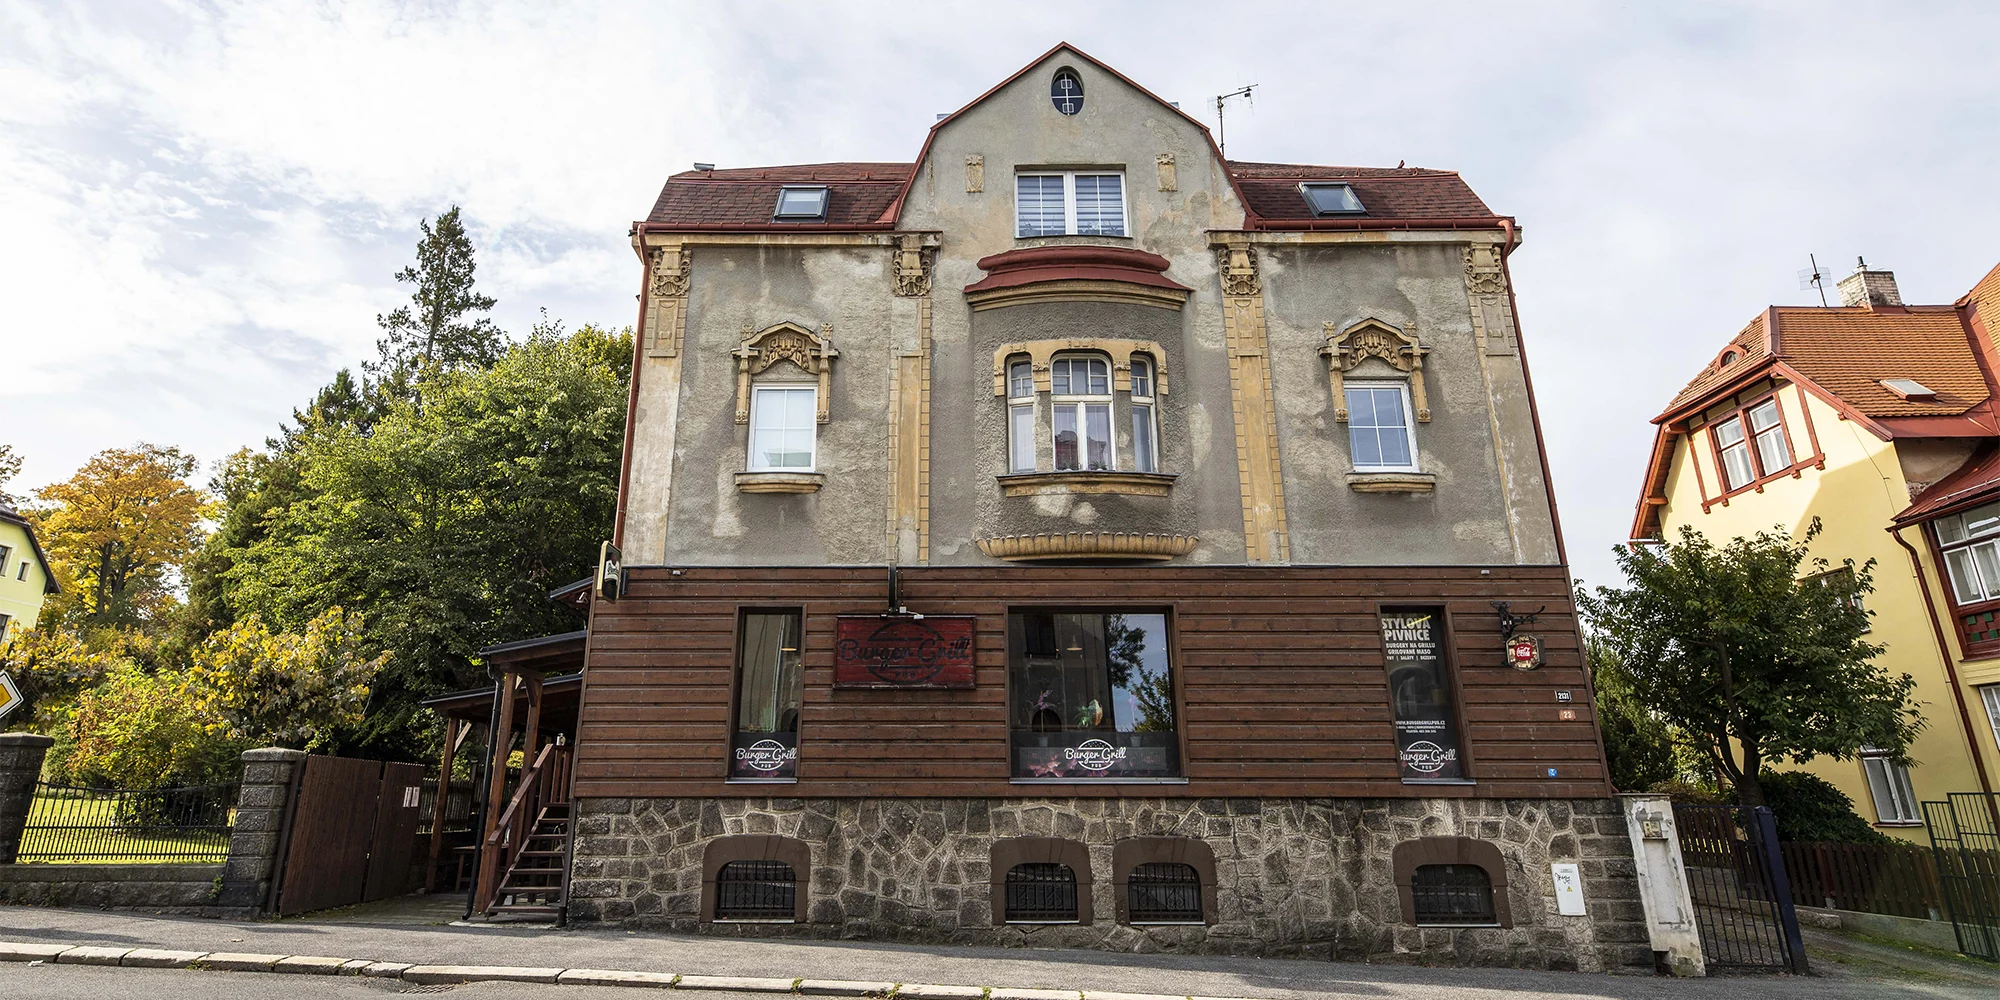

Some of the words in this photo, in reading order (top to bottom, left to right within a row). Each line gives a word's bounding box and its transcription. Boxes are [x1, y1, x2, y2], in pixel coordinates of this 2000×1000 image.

[1384, 629, 1430, 641] PIVNICE
[839, 638, 915, 671] Burger
[919, 636, 971, 669] Grill
[1563, 711, 1572, 719] 23
[735, 748, 771, 764] Burger
[772, 747, 797, 763] Grill
[1064, 747, 1100, 764] Burger
[1101, 746, 1127, 763] Grill
[1431, 748, 1457, 765] Grill
